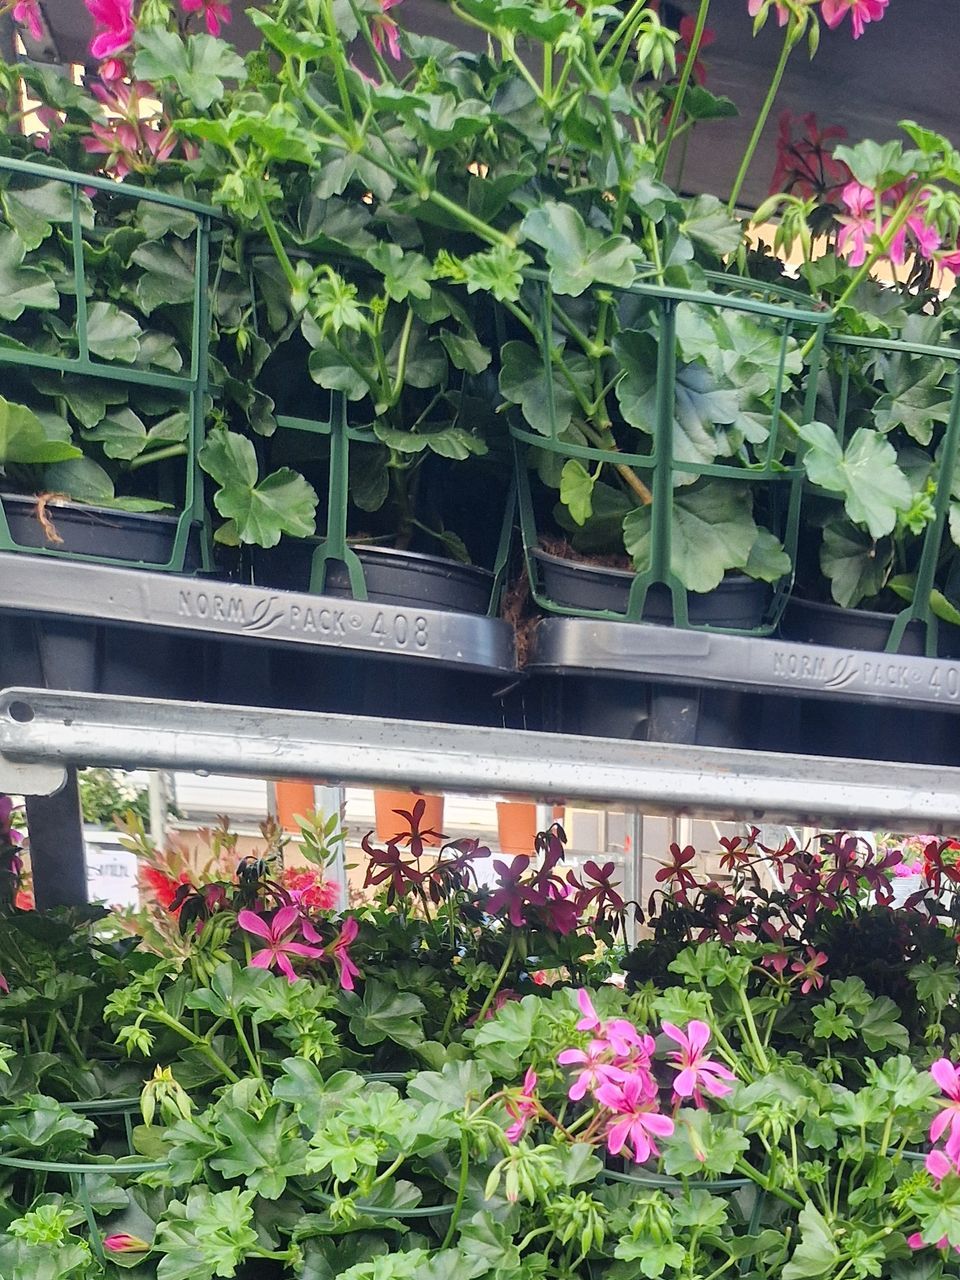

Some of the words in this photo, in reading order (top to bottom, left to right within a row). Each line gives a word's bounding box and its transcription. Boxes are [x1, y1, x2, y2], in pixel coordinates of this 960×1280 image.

[178, 590, 246, 624] NORM
[371, 611, 429, 651] 408
[773, 652, 828, 681] NORM
